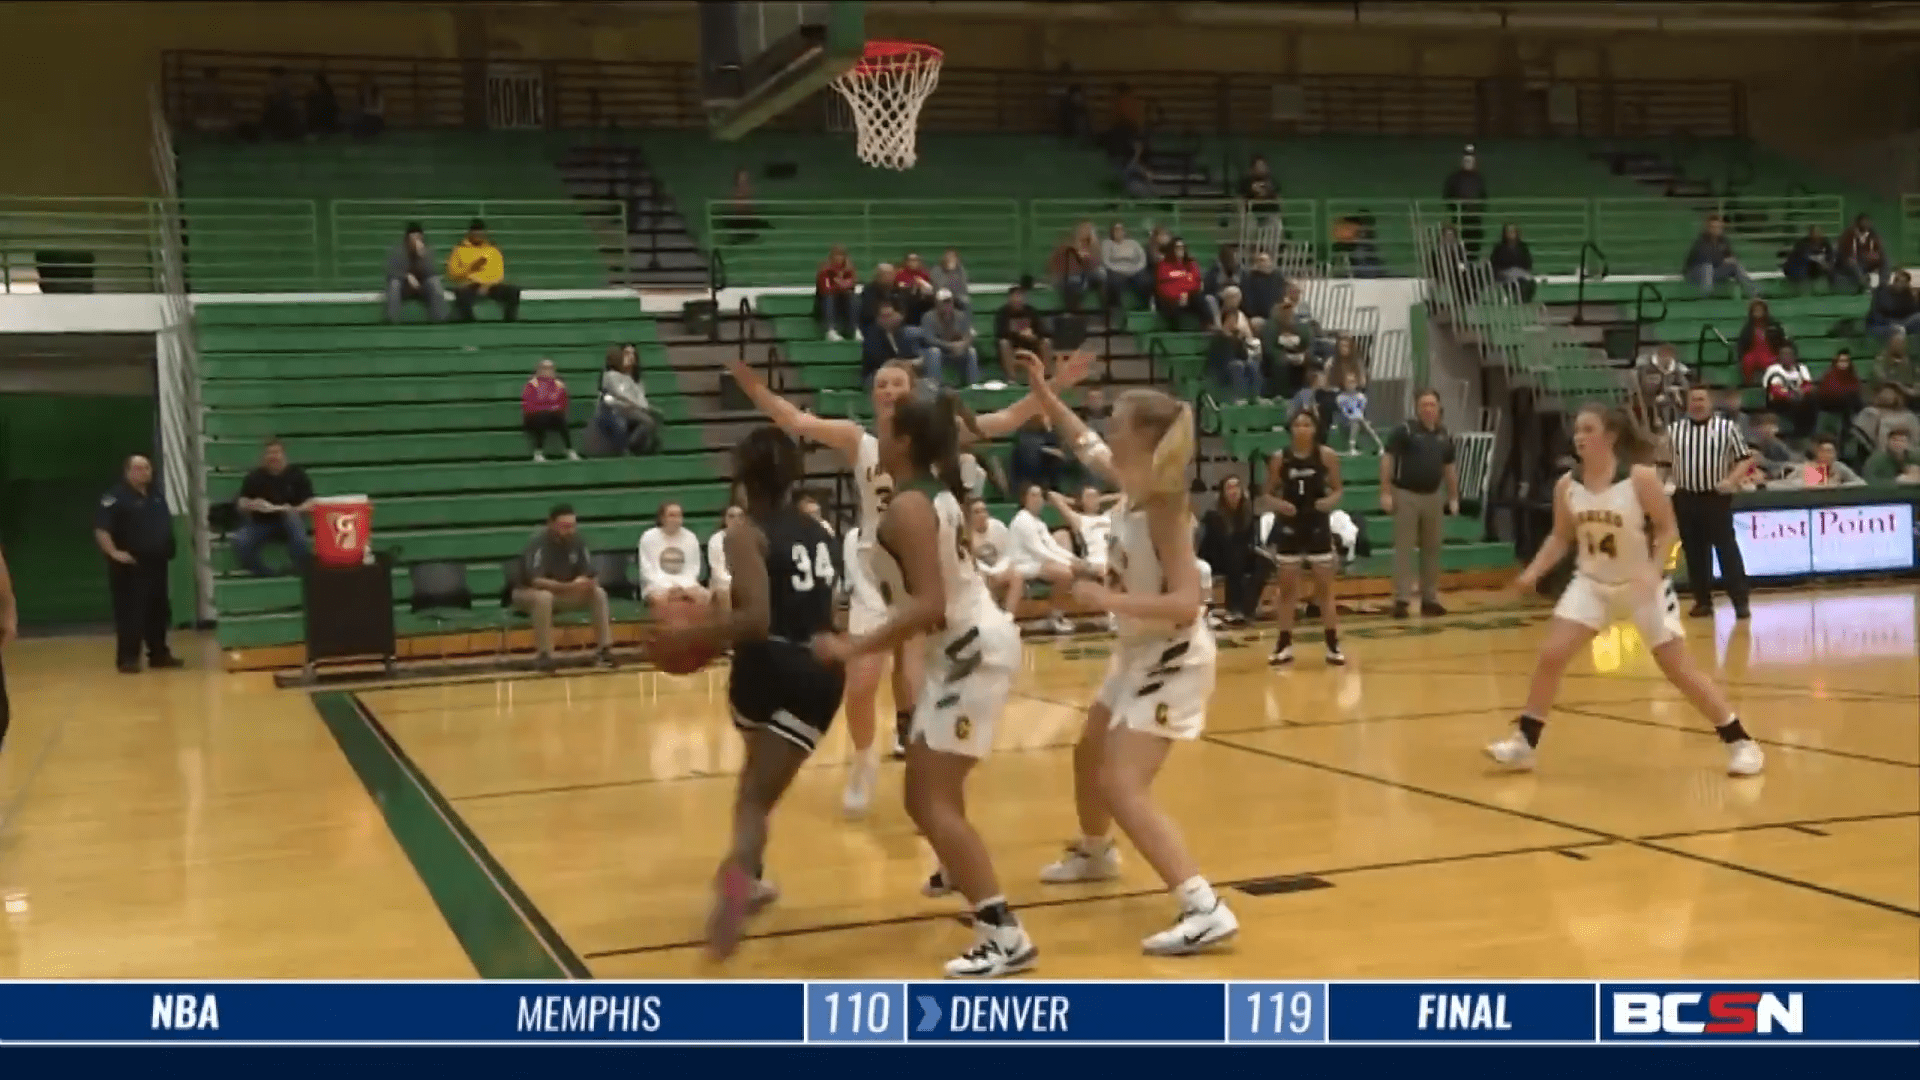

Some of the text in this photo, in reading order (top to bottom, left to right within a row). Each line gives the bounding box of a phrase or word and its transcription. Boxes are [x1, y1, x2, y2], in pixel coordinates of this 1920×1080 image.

[488, 77, 541, 127] HOME
[1298, 479, 1305, 495] 1
[1751, 509, 1896, 540] East Point
[1585, 531, 1618, 558] 14
[790, 542, 835, 592] 34
